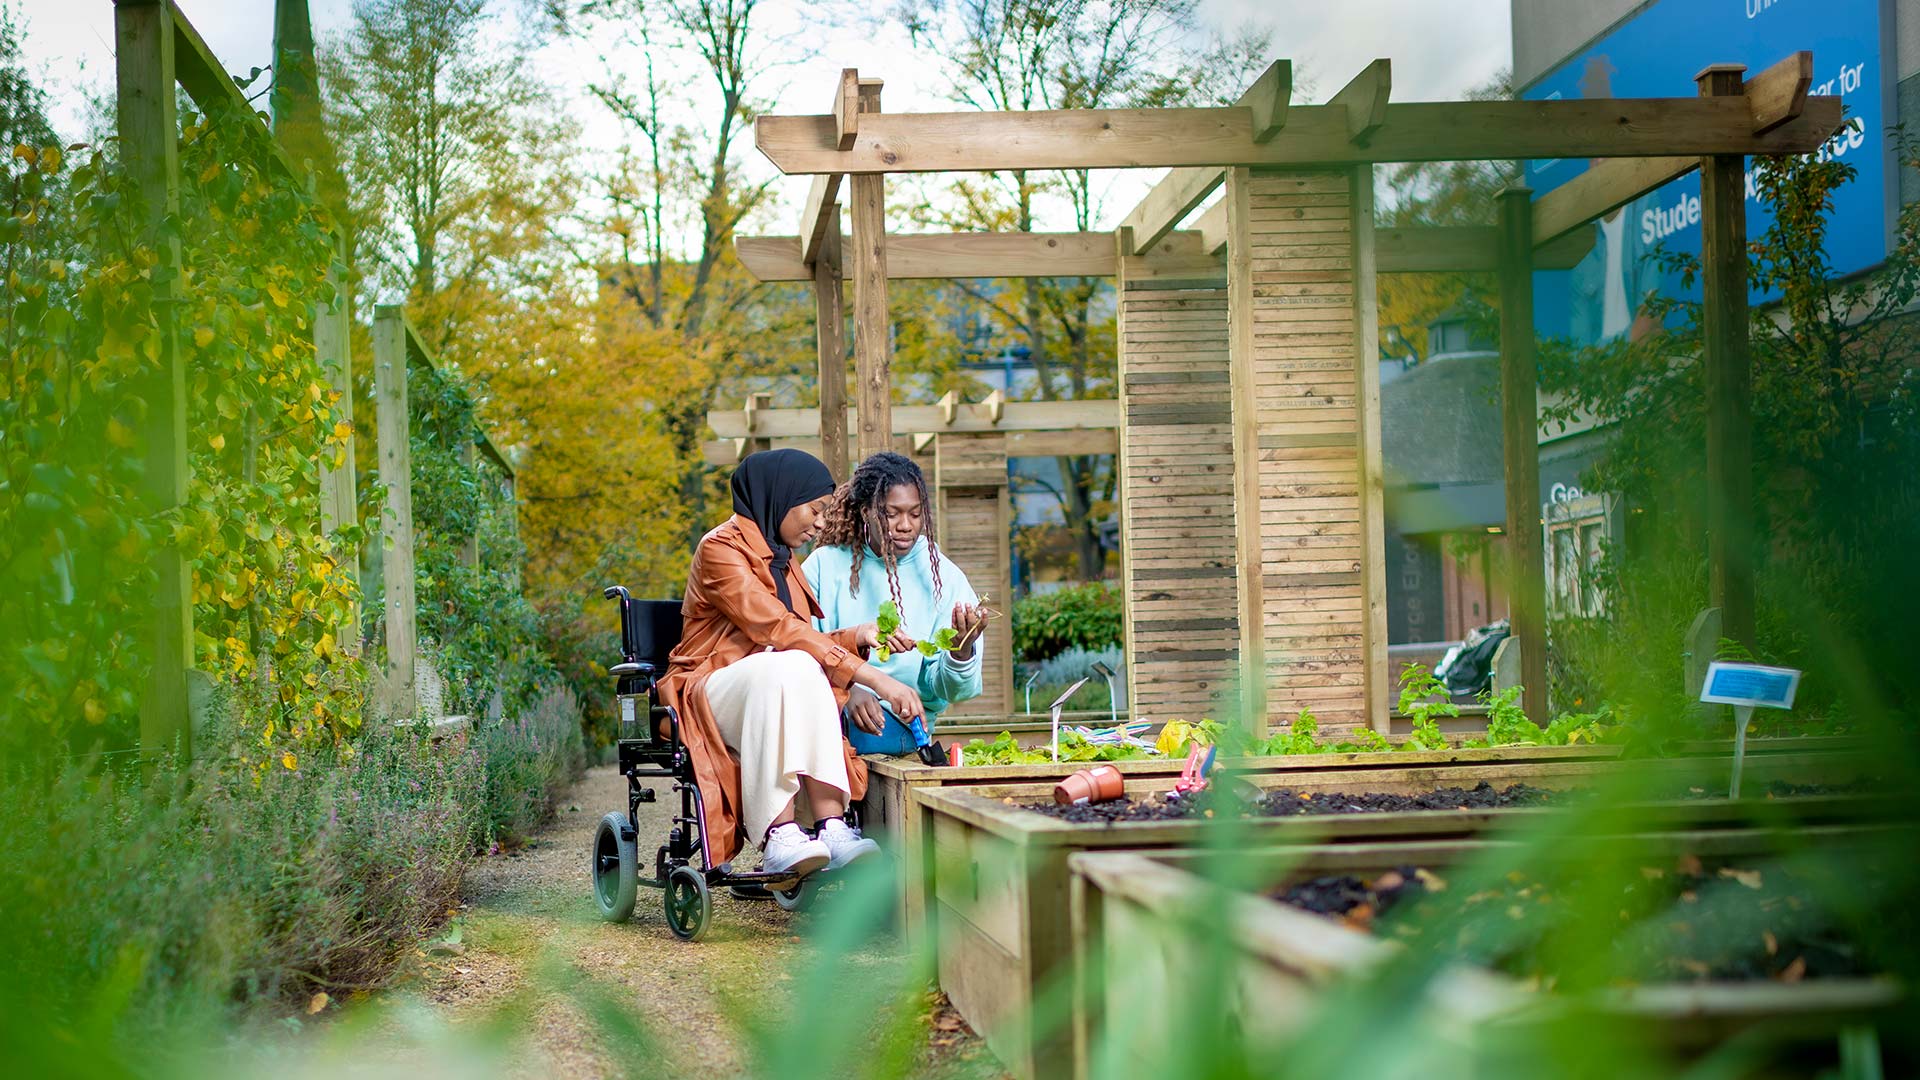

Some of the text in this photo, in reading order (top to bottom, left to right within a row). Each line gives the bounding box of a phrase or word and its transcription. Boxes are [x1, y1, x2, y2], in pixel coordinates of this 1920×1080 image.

[1839, 62, 1864, 97] for
[1641, 192, 1702, 245] Stude
[1551, 482, 1583, 505] Ge
